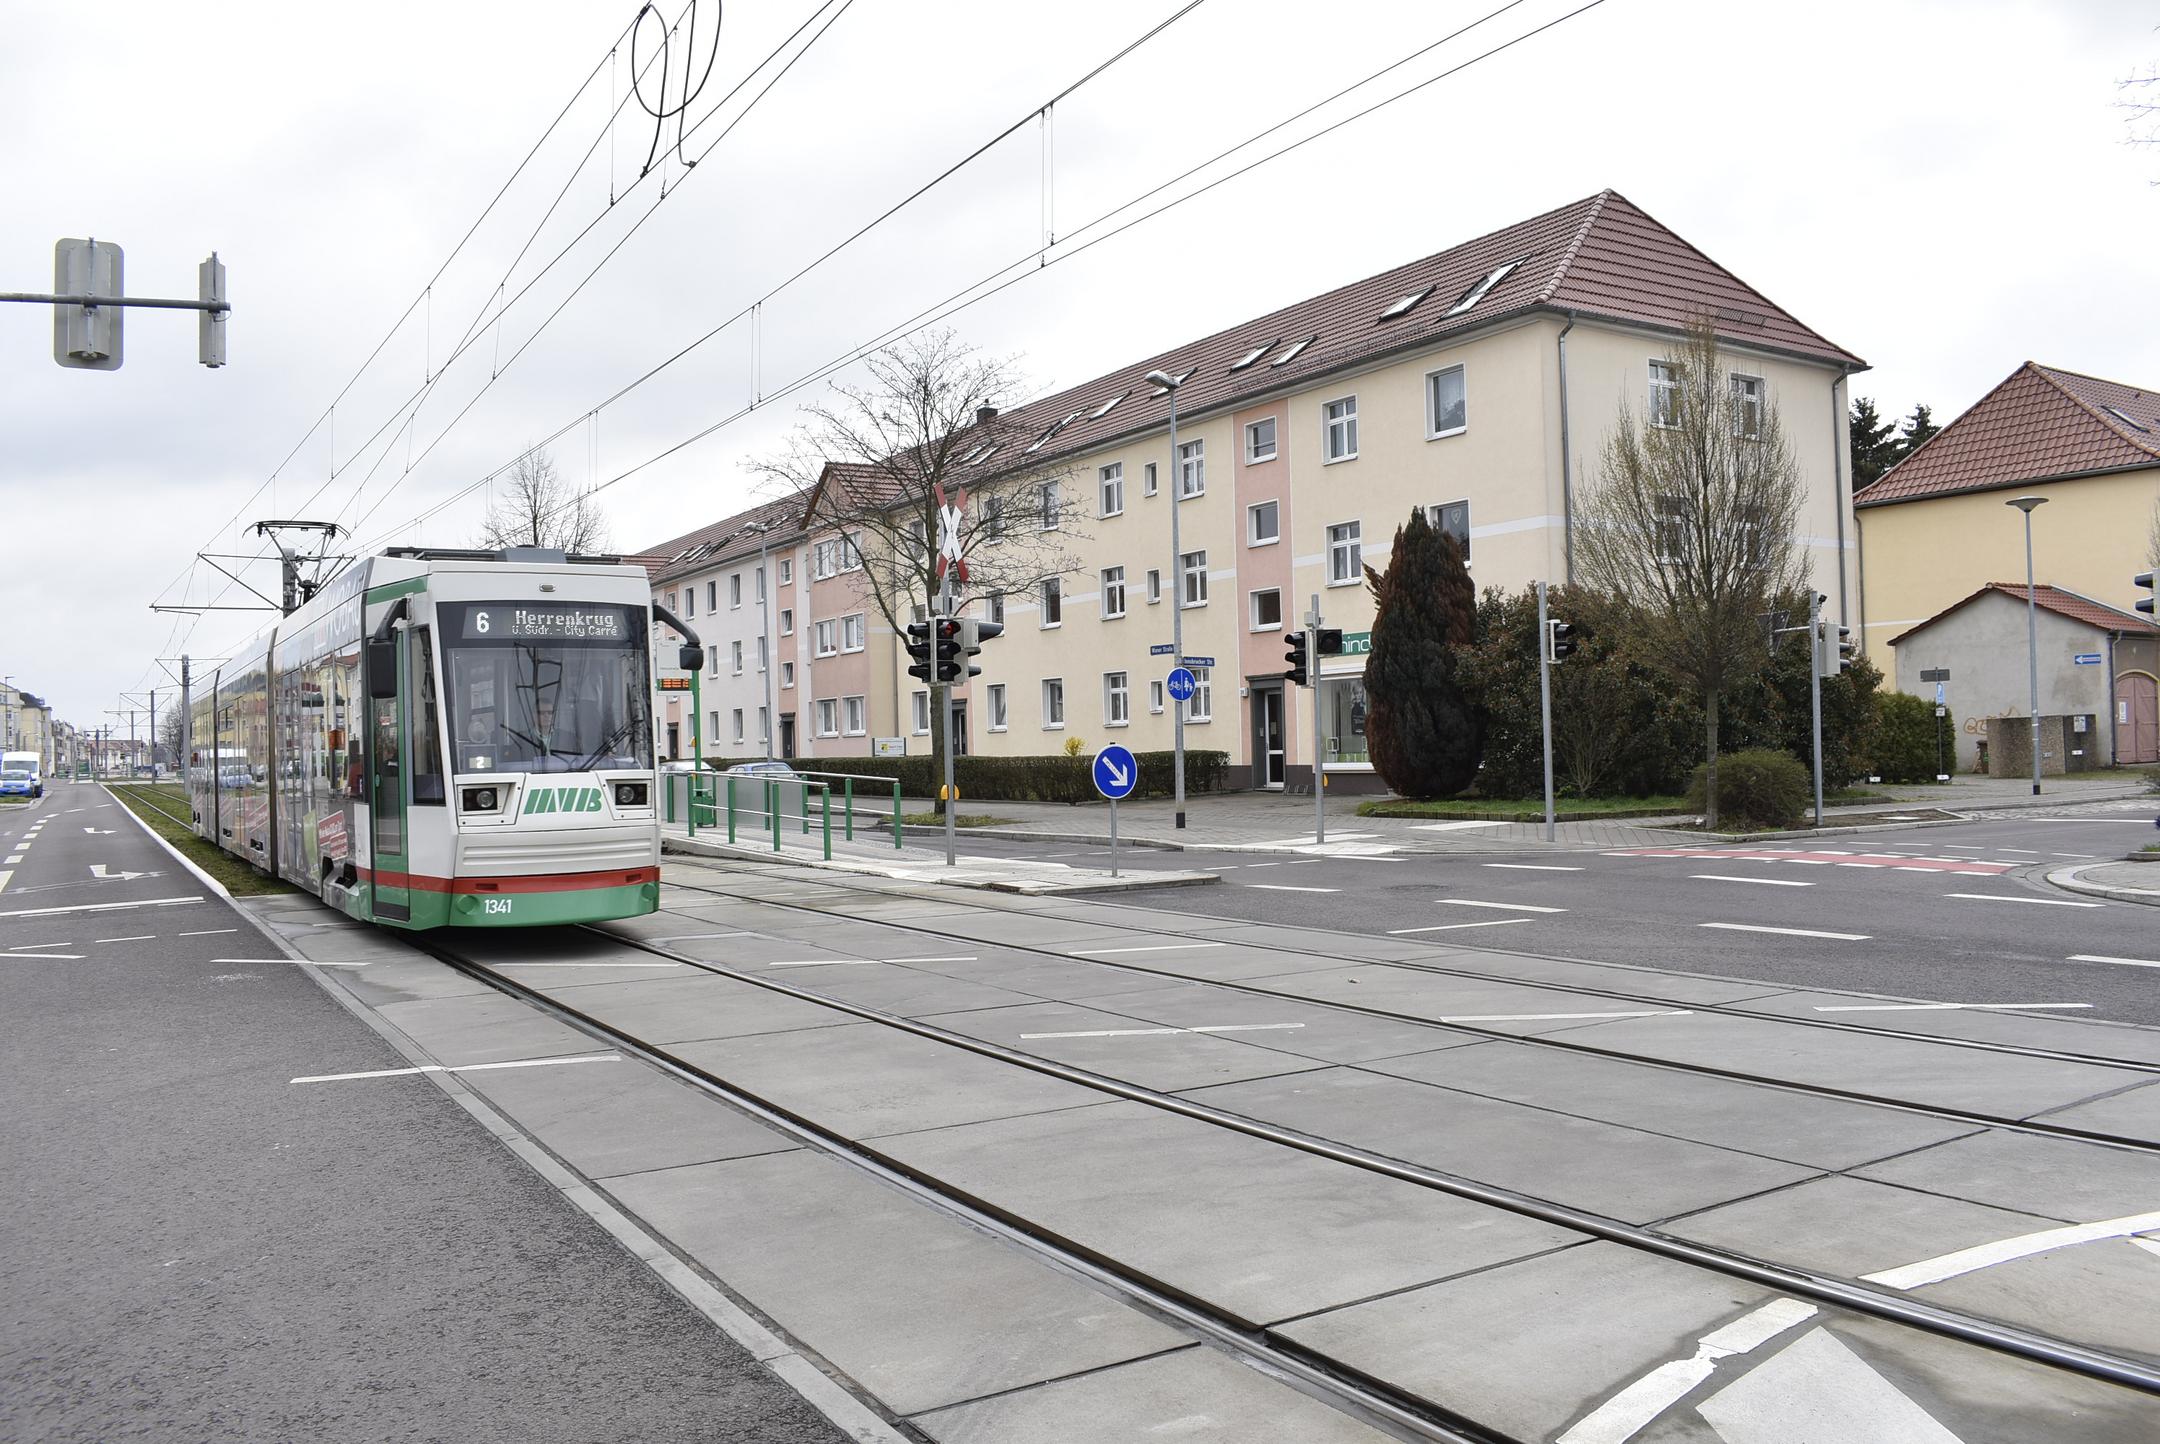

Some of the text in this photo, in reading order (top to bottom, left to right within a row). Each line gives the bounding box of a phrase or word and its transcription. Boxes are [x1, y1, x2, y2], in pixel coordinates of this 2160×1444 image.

[476, 610, 614, 633] 6 Herrenkrug
[564, 624, 585, 637] City
[588, 625, 618, 636] Carré
[476, 756, 485, 769] 2
[523, 787, 603, 815] MVB
[484, 898, 513, 914] 1341
